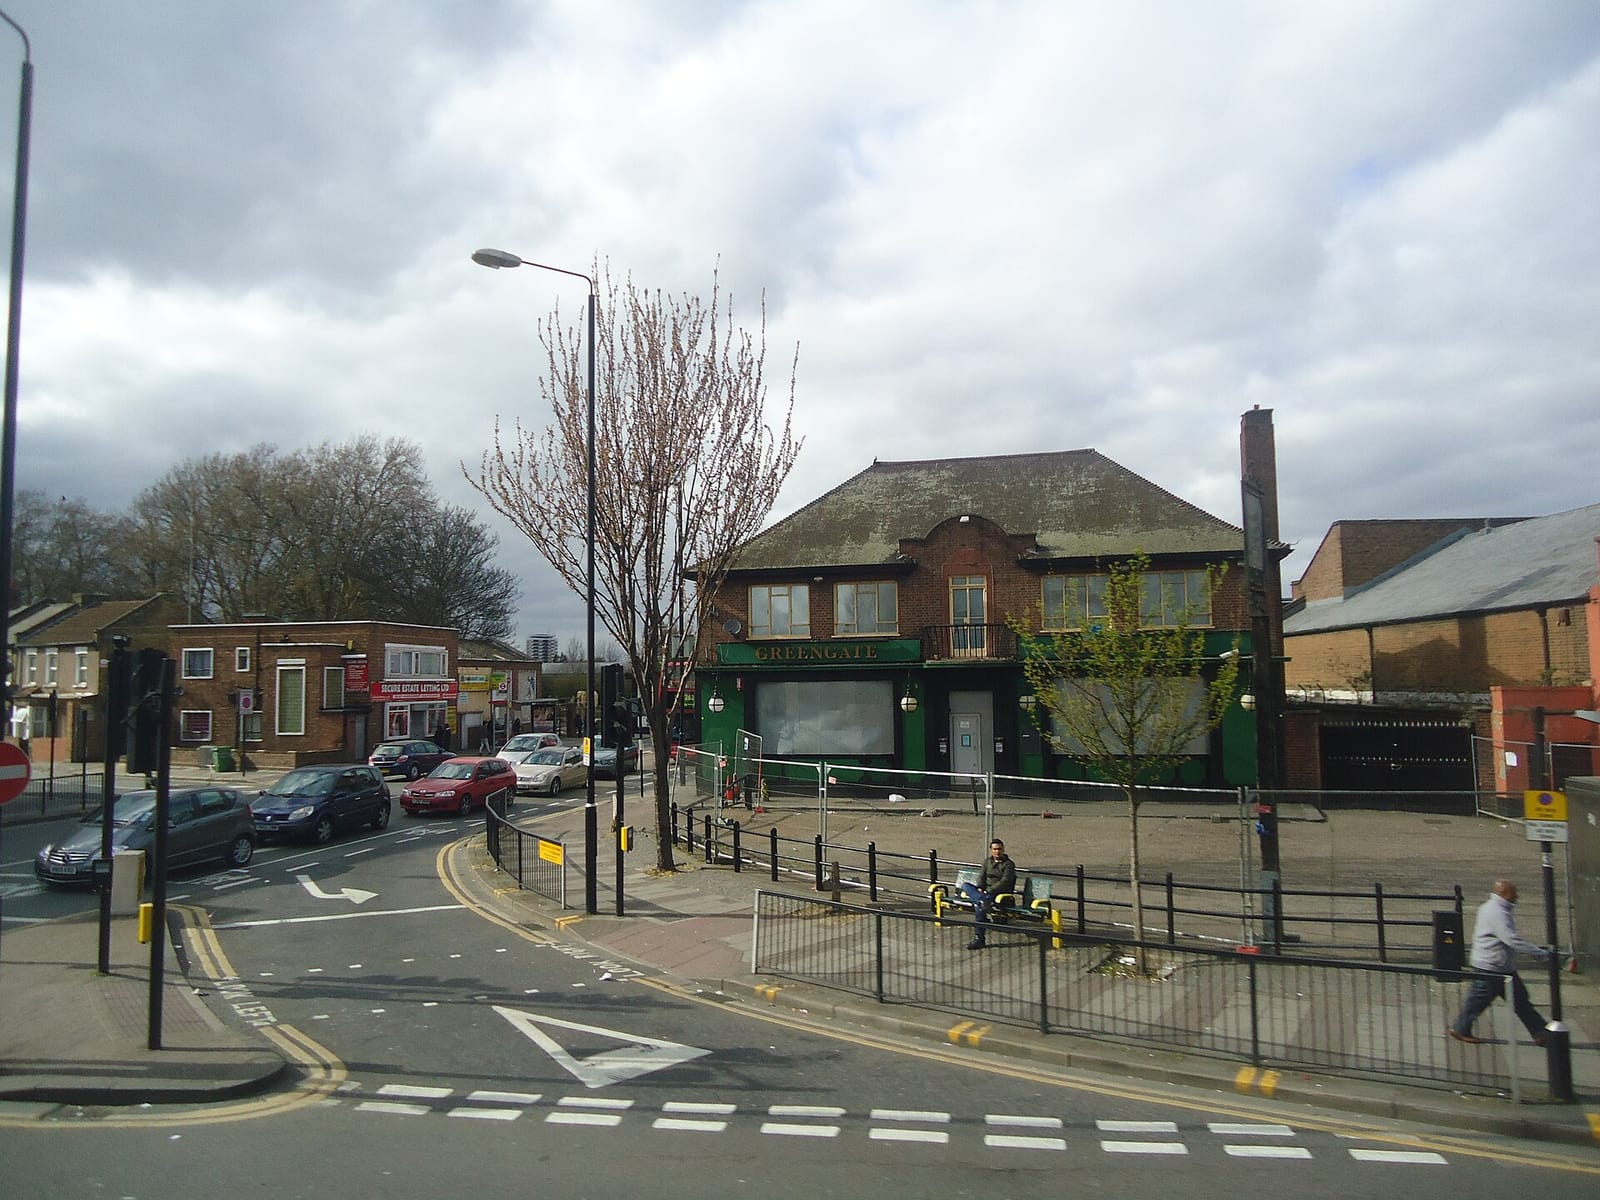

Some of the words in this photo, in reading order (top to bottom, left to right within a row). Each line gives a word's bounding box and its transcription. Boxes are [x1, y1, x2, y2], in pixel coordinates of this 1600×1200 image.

[755, 645, 877, 660] GREENGATE
[402, 684, 419, 692] ESTATE
[230, 1001, 278, 1023] LEFT
